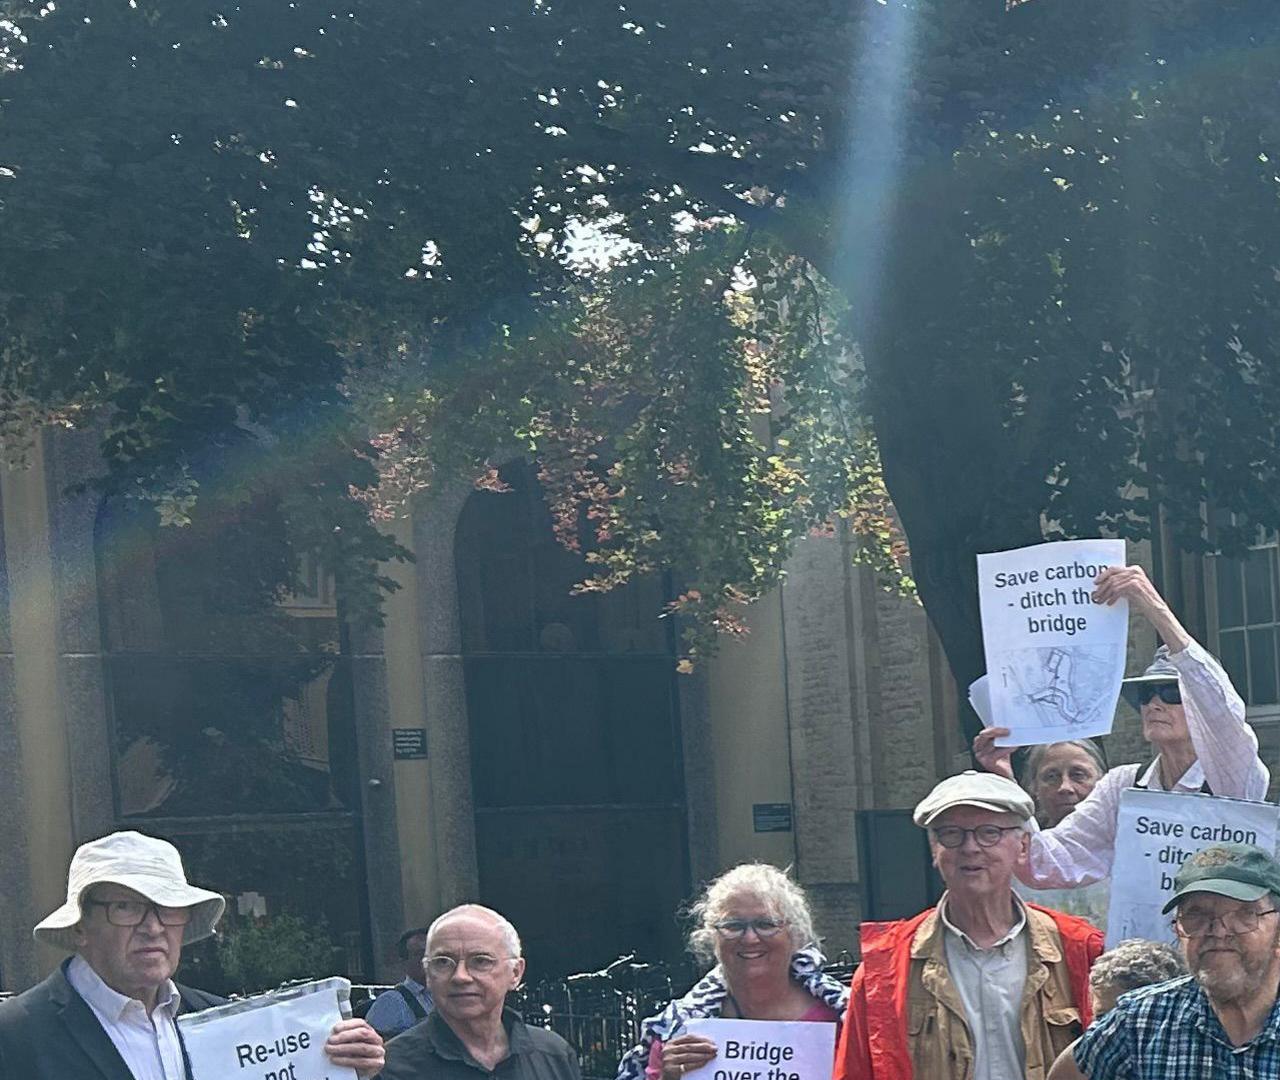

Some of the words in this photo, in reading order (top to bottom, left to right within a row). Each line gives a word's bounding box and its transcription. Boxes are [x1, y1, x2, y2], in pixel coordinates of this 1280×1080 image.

[994, 570, 1040, 589] Save
[1020, 588, 1067, 610] ditch
[1027, 615, 1087, 636] bridge
[1135, 815, 1185, 839] Save
[1190, 822, 1257, 845] carbon
[235, 1029, 312, 1068] Re-use
[725, 1040, 794, 1065] Bridge
